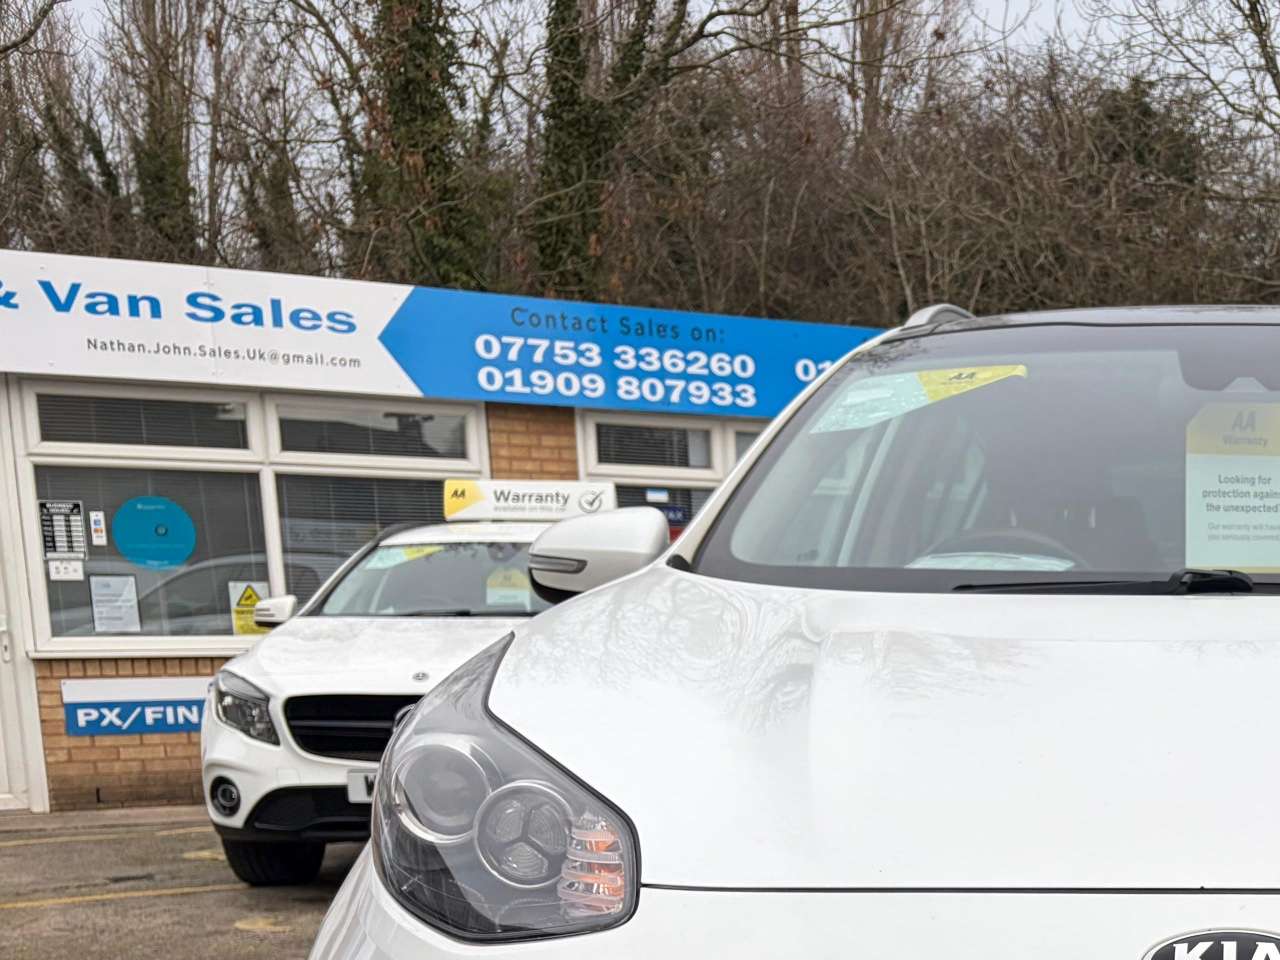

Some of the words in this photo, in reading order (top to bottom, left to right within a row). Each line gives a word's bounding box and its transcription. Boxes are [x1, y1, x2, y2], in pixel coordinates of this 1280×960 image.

[37, 280, 162, 319] Van
[185, 291, 358, 335] Sales
[511, 307, 608, 333] Contact
[619, 316, 680, 340] Sales
[691, 326, 726, 344] on:
[474, 333, 603, 367] 07753
[613, 344, 756, 379] 336260
[477, 366, 606, 398] 01909
[616, 375, 758, 408] 807933
[1218, 474, 1256, 486] Looking
[1258, 475, 1272, 485] for
[450, 488, 467, 499] AA
[494, 490, 571, 507] Warranty
[1202, 488, 1250, 499] protection
[1206, 503, 1221, 512] the
